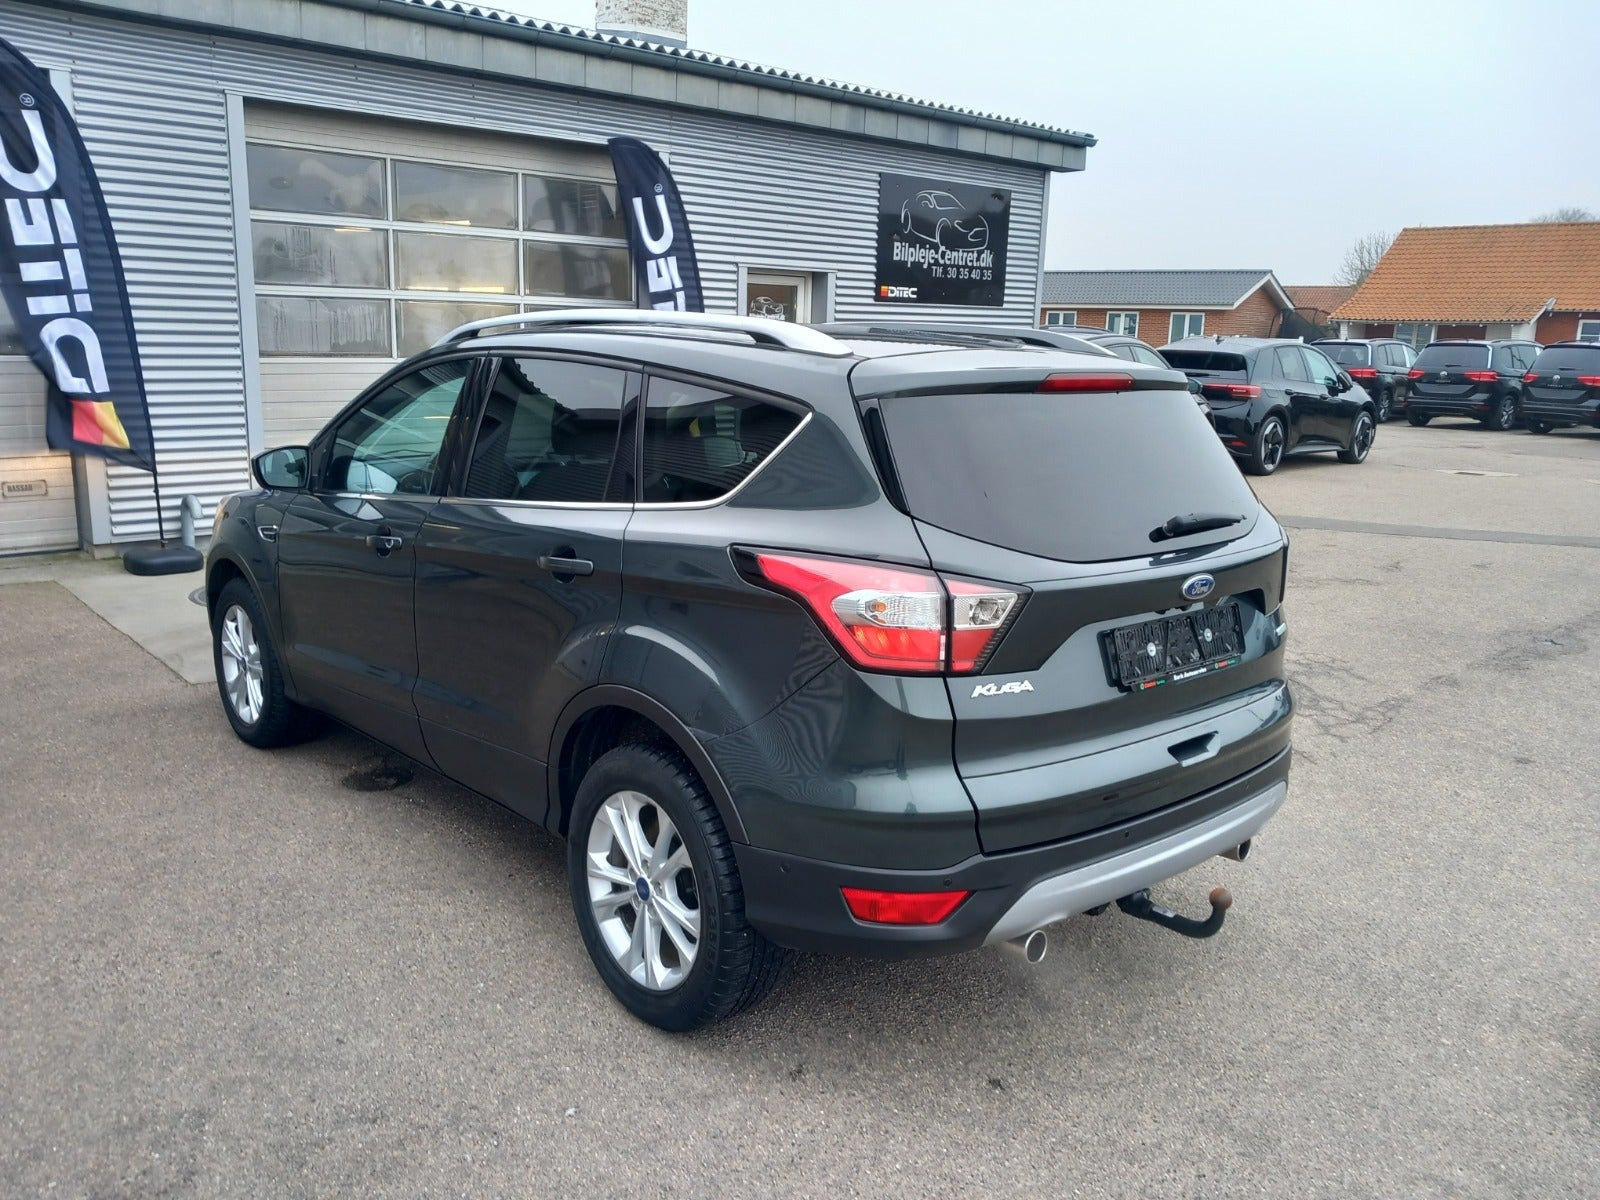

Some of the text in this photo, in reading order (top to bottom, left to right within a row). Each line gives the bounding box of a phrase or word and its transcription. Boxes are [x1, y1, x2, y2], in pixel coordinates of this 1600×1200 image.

[893, 241, 993, 268] Bilpleje-Centret.dk
[931, 266, 992, 281] Tlf. 30 35 40 35
[971, 680, 1034, 698] KUGA
